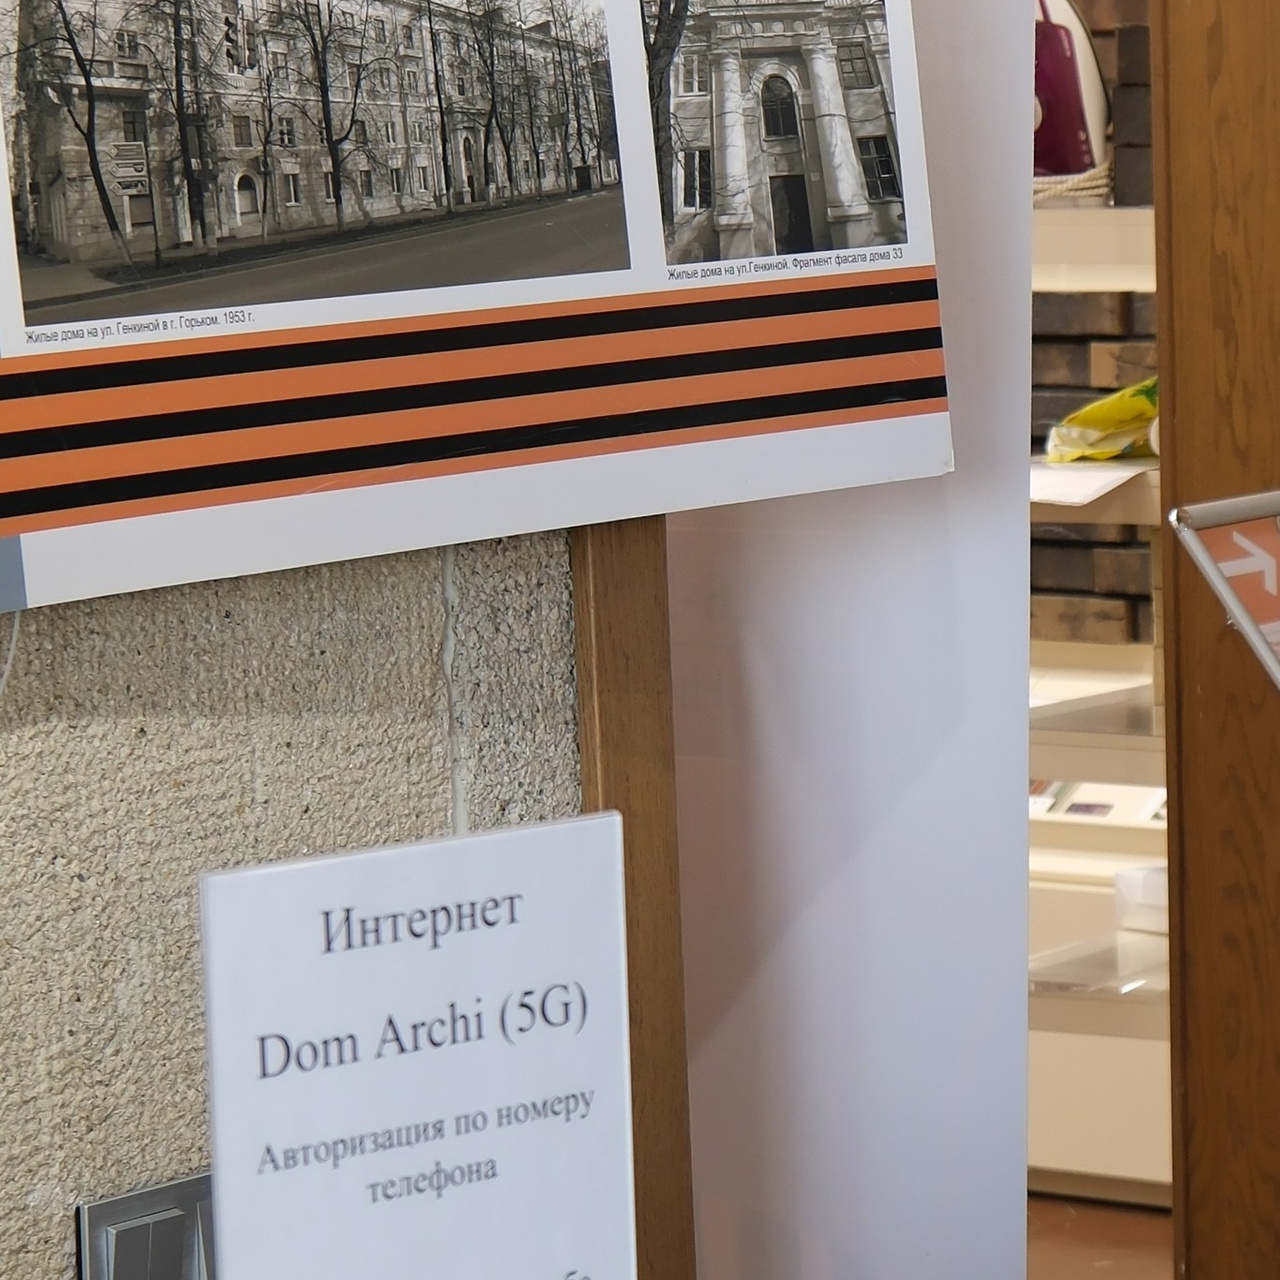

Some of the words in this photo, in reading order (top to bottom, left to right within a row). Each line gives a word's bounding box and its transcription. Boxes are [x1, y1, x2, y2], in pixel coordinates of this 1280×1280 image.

[667, 267, 699, 281] Жилые
[700, 265, 723, 279] дома
[724, 264, 735, 276] на
[792, 254, 833, 272] Фрагмент
[868, 248, 891, 263] дома
[892, 246, 904, 260] 33
[26, 331, 59, 345] Жилые
[60, 329, 85, 342] дома
[86, 326, 99, 339] на
[100, 327, 114, 340] ул.
[116, 318, 161, 336] Генкиной
[179, 314, 222, 331] Горьком.
[222, 310, 246, 325] 1953
[320, 893, 524, 955] Интернет
[255, 1032, 360, 1080] Dom
[374, 996, 486, 1060] Archi
[499, 980, 588, 1046] (5G)
[256, 1119, 447, 1175] Авторизация
[454, 1110, 489, 1136] по
[495, 1089, 596, 1130] номеру
[365, 1157, 499, 1205] телефона
